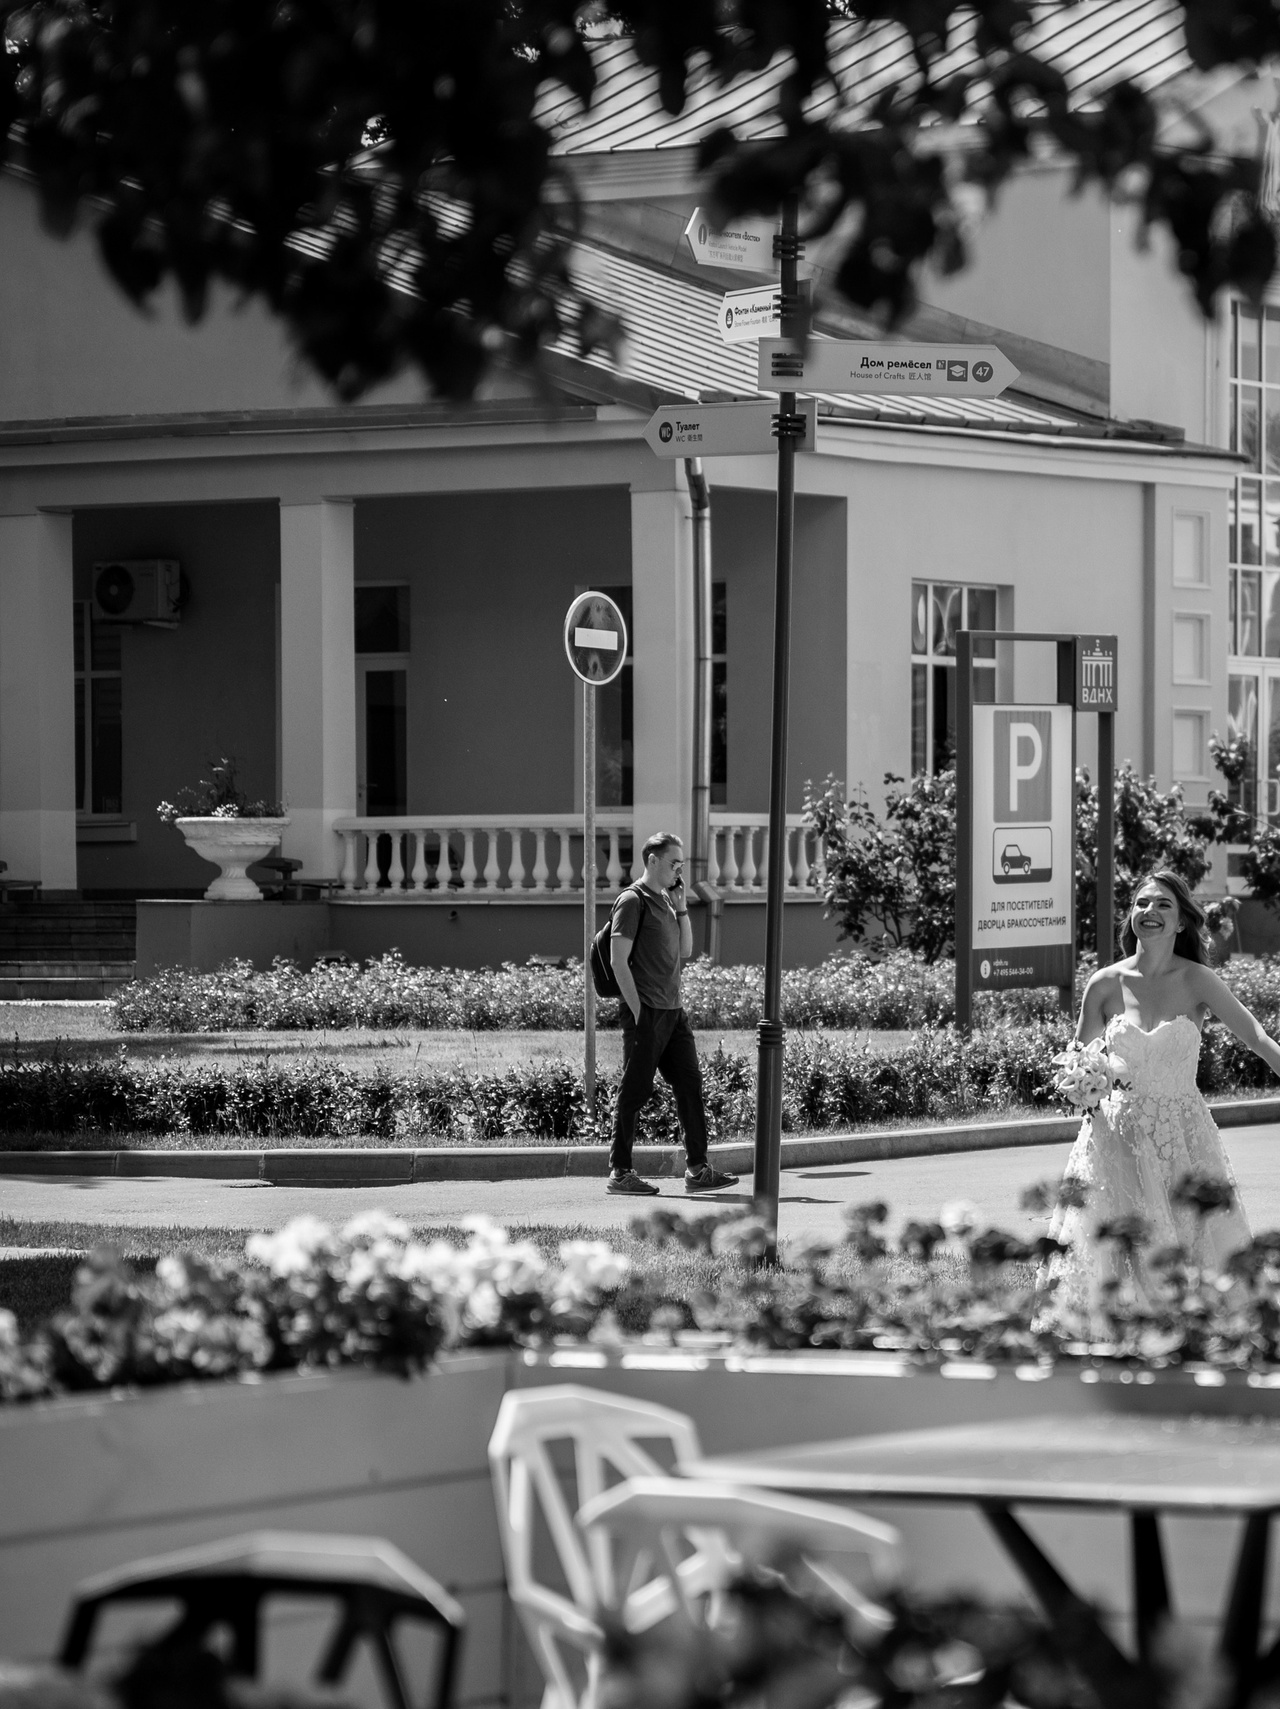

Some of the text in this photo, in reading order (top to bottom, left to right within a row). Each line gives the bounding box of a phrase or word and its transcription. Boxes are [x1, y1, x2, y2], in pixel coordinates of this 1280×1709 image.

[734, 306, 749, 315] Фонтан
[860, 357, 932, 370] Дом ремёсел
[850, 371, 905, 380] House of Crafts
[975, 367, 990, 377] 47
[661, 427, 671, 438] WC
[676, 421, 700, 433] Туалет
[1082, 688, 1113, 704] ВДНХ
[1009, 722, 1043, 812] P
[991, 897, 1054, 913] ДЛЯ ПОСЕТИТЕЛЕЙ
[978, 916, 1067, 931] ДВОРЦА БРАКОСОЧЕТАНИЯ
[1009, 966, 1034, 976] 544-34-00
